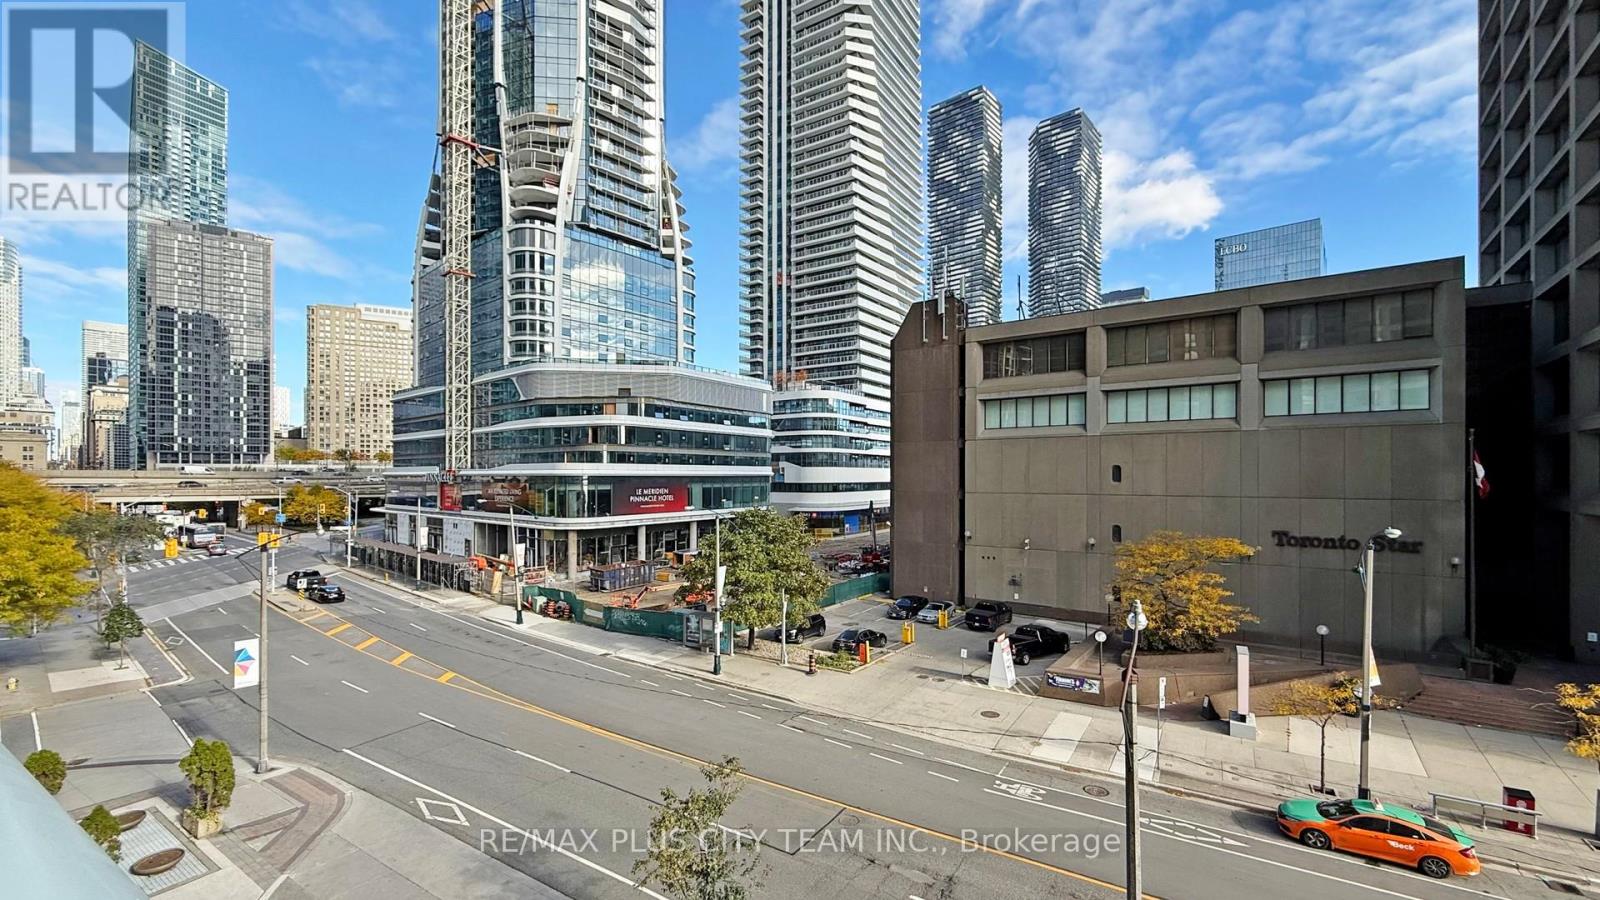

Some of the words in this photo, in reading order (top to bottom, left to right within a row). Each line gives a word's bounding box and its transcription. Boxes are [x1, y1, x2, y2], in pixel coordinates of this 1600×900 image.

[1220, 243, 1247, 256] LCBO
[1271, 530, 1361, 550] Toronto
[1371, 535, 1424, 553] Star
[1388, 840, 1416, 851] Beck
